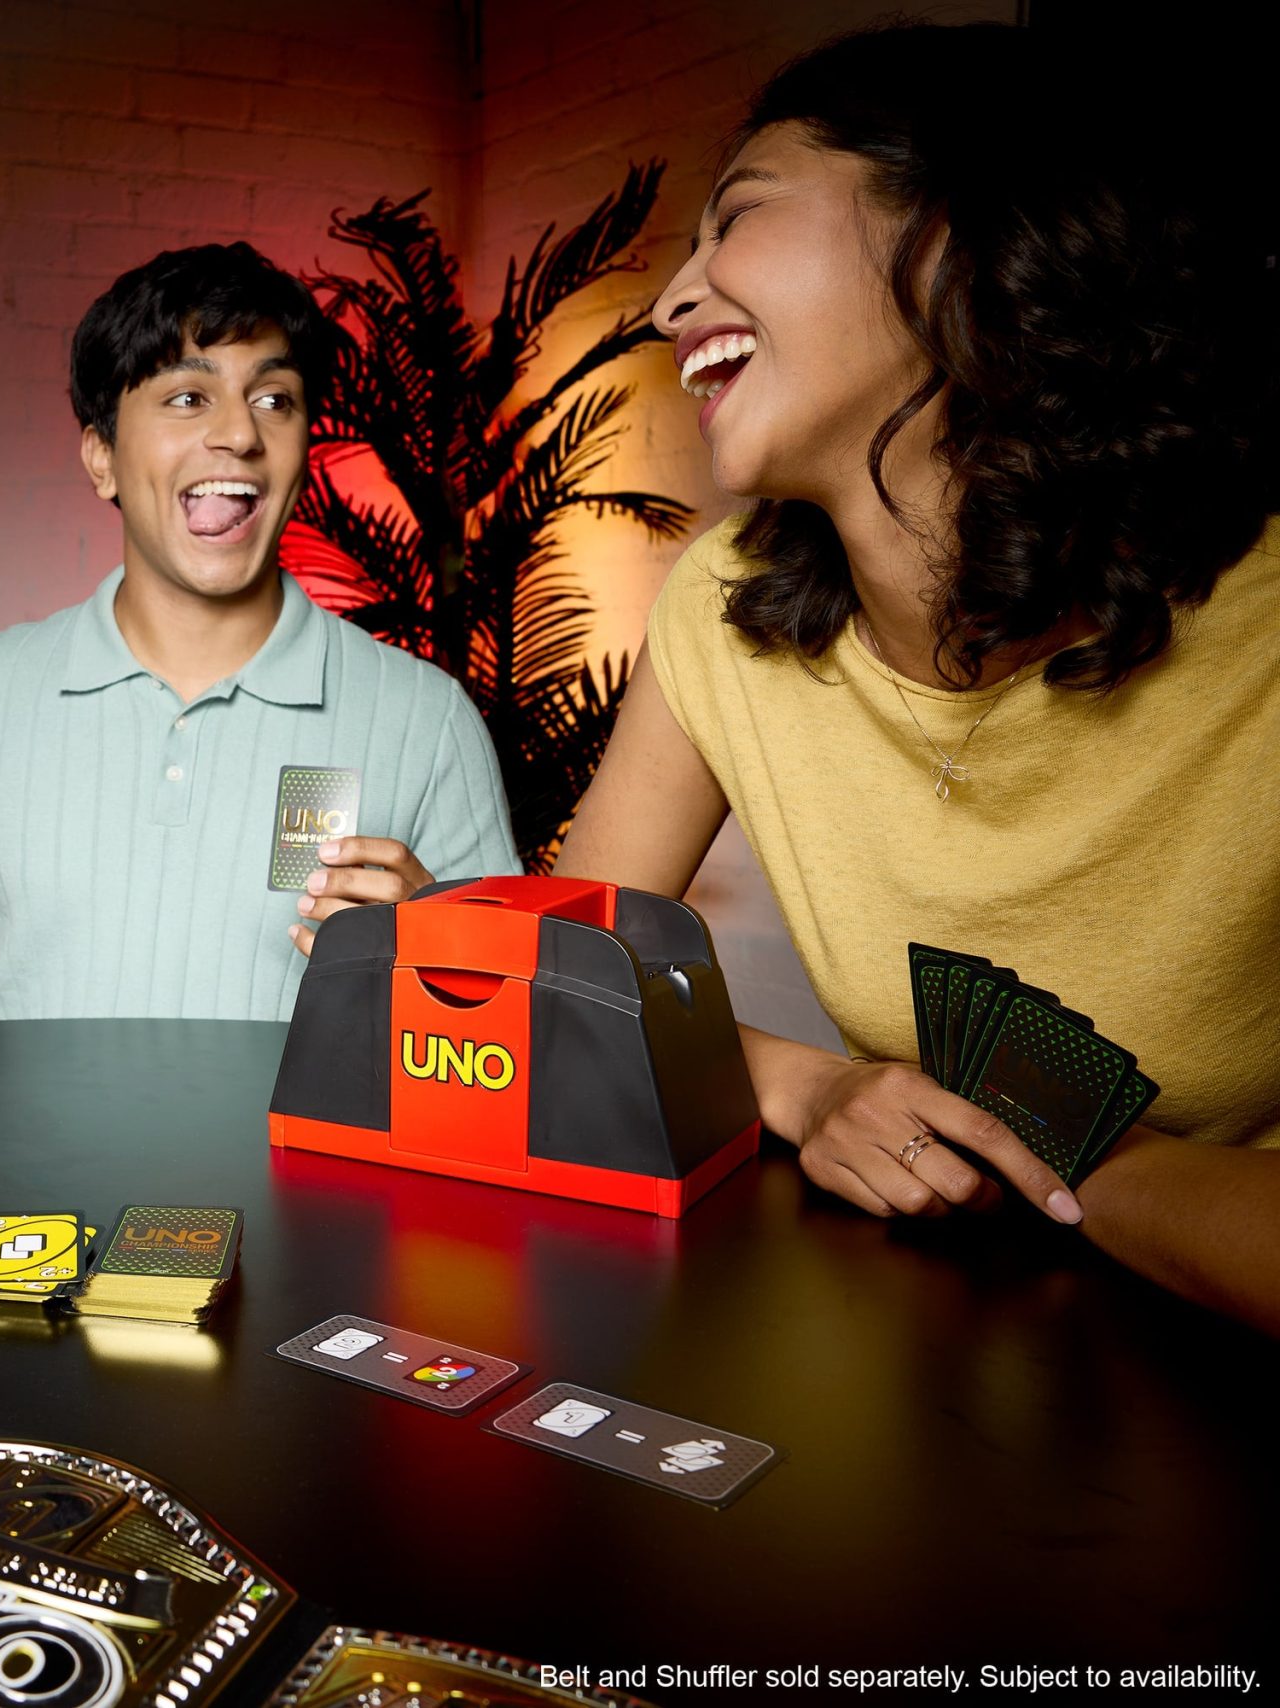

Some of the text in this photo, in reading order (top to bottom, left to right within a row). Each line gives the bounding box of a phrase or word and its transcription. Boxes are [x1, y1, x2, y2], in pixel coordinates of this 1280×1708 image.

[283, 807, 348, 834] UNO
[401, 1030, 516, 1092] UNO
[120, 1240, 219, 1250] CHAMPIONSHIP
[124, 1227, 222, 1244] UNO
